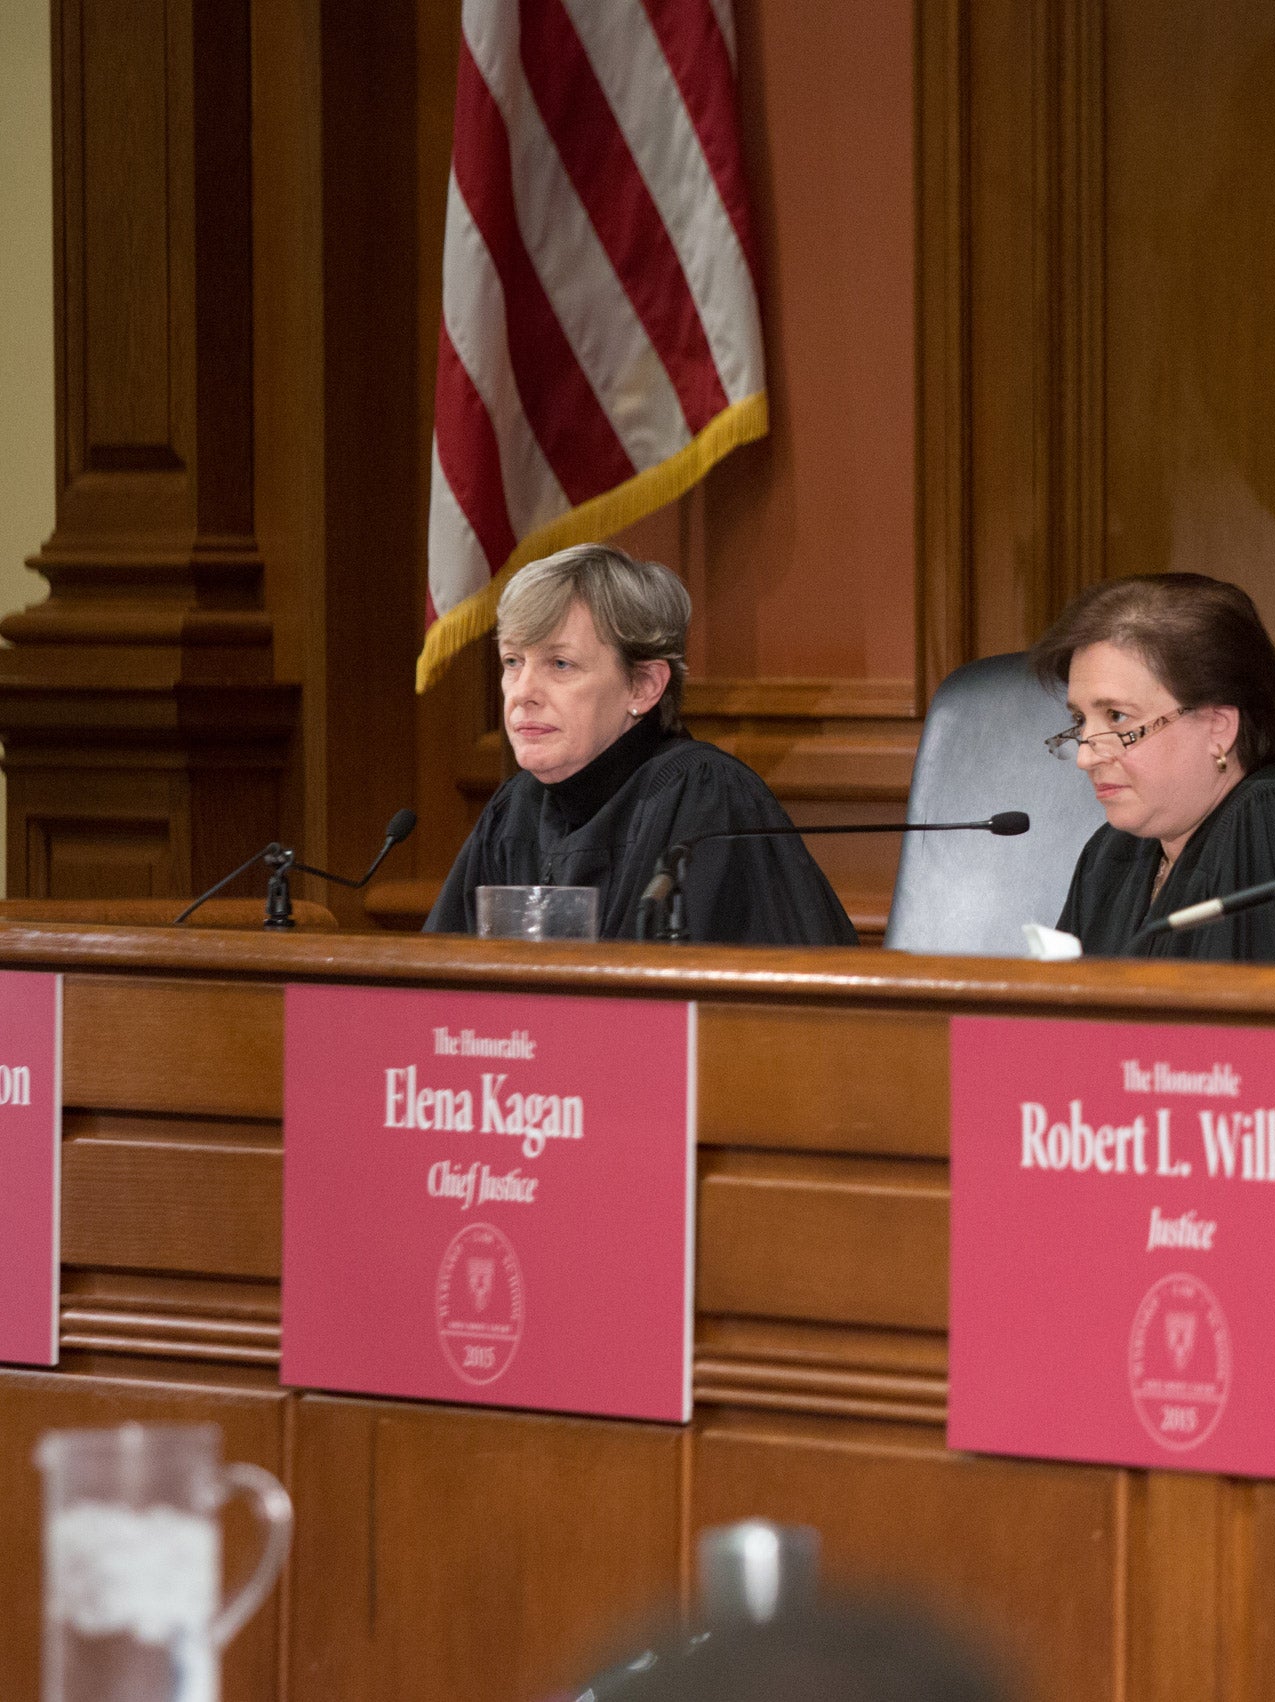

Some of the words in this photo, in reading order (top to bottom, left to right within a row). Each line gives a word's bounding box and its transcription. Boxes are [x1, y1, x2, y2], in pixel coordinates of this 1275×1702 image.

[433, 1026, 459, 1055] The
[460, 1029, 537, 1060] Honorable
[1121, 1059, 1152, 1093] The
[1152, 1061, 1241, 1097] Honorable
[384, 1064, 475, 1132] Elena
[480, 1073, 585, 1159] Kagan
[1020, 1099, 1147, 1175] Robert
[1156, 1108, 1192, 1177] L.
[428, 1160, 481, 1210] Chief
[477, 1165, 539, 1205] Justice
[1147, 1206, 1217, 1252] Justice
[463, 1345, 496, 1368] 2015
